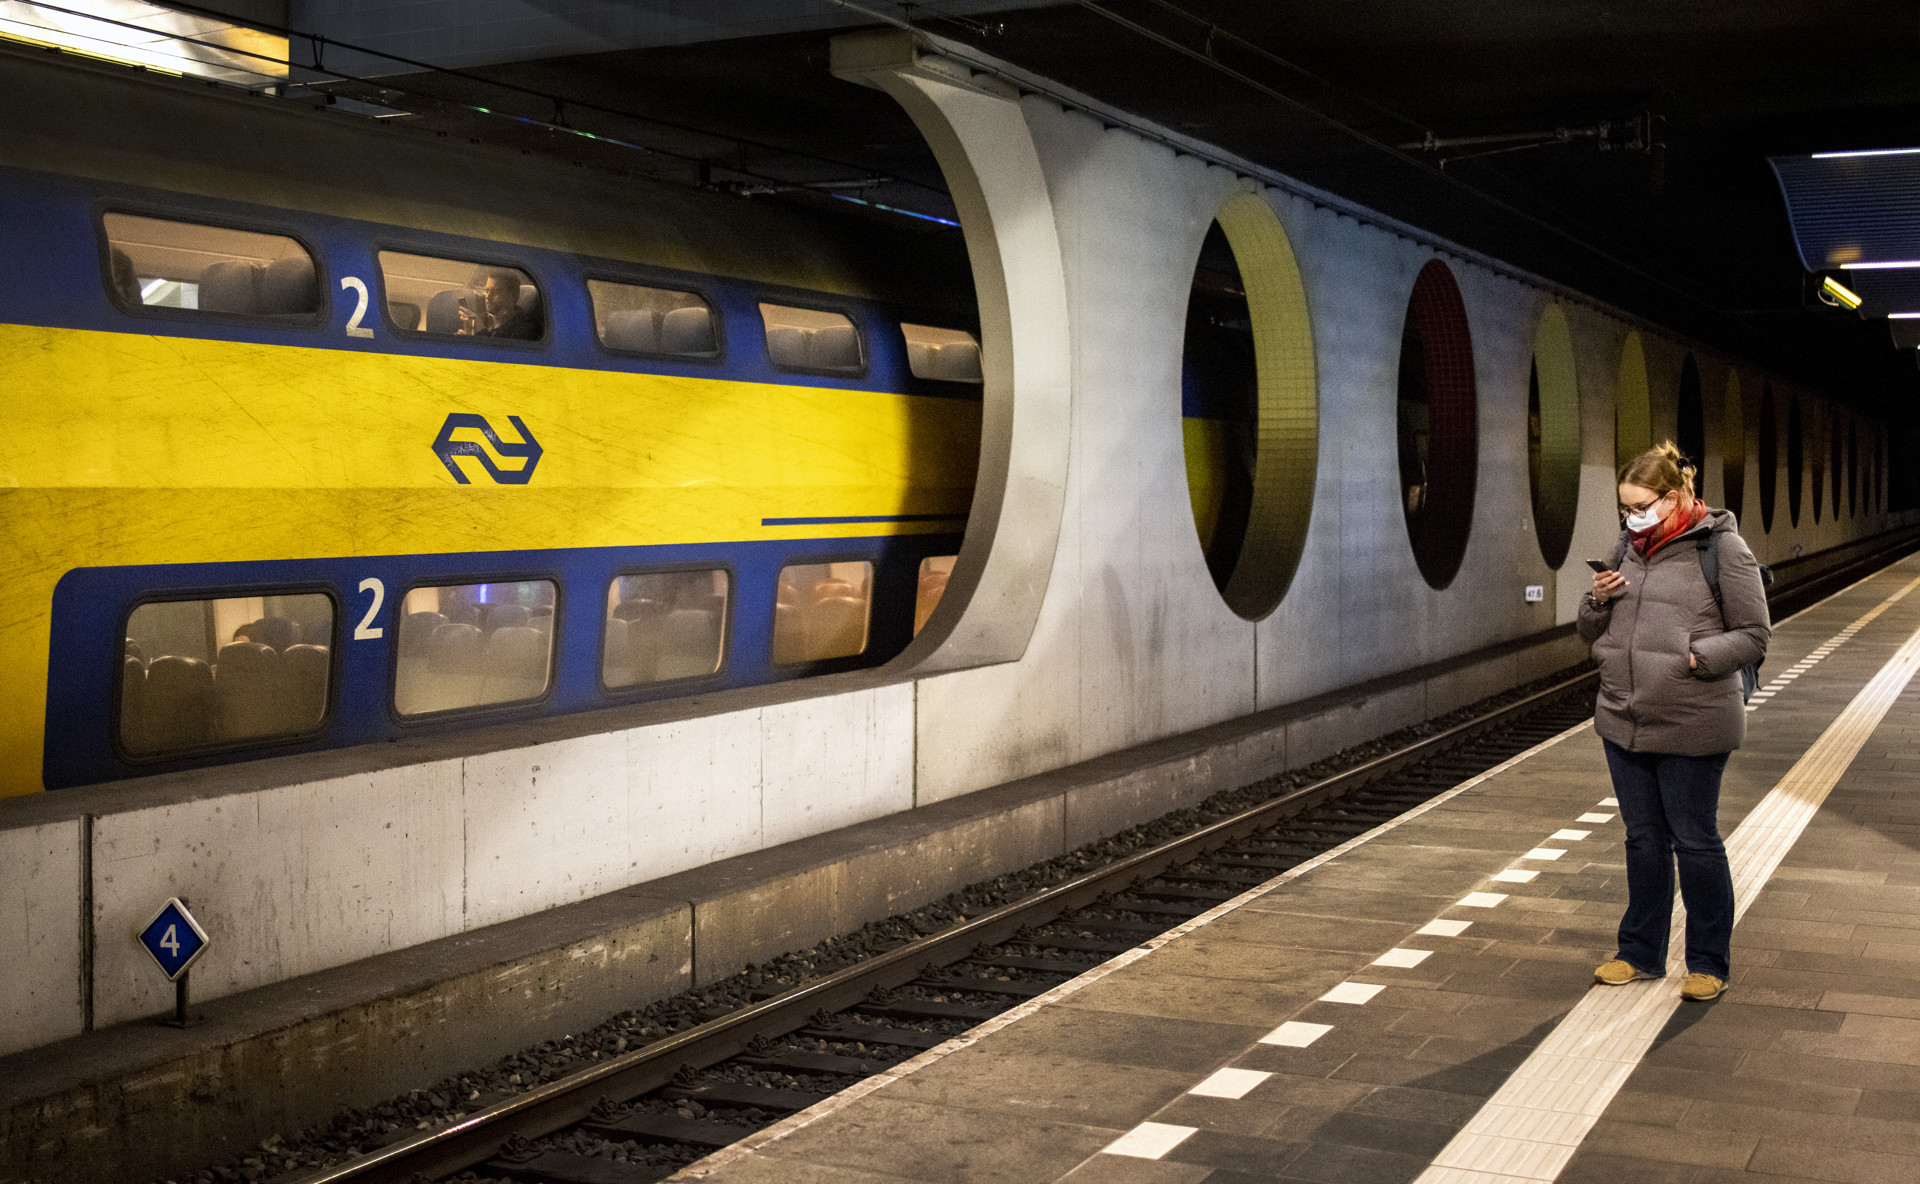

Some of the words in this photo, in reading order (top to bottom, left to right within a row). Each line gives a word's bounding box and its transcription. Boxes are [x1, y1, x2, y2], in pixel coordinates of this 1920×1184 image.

[341, 276, 374, 338] 2
[353, 577, 384, 640] 2
[160, 924, 180, 957] 4
